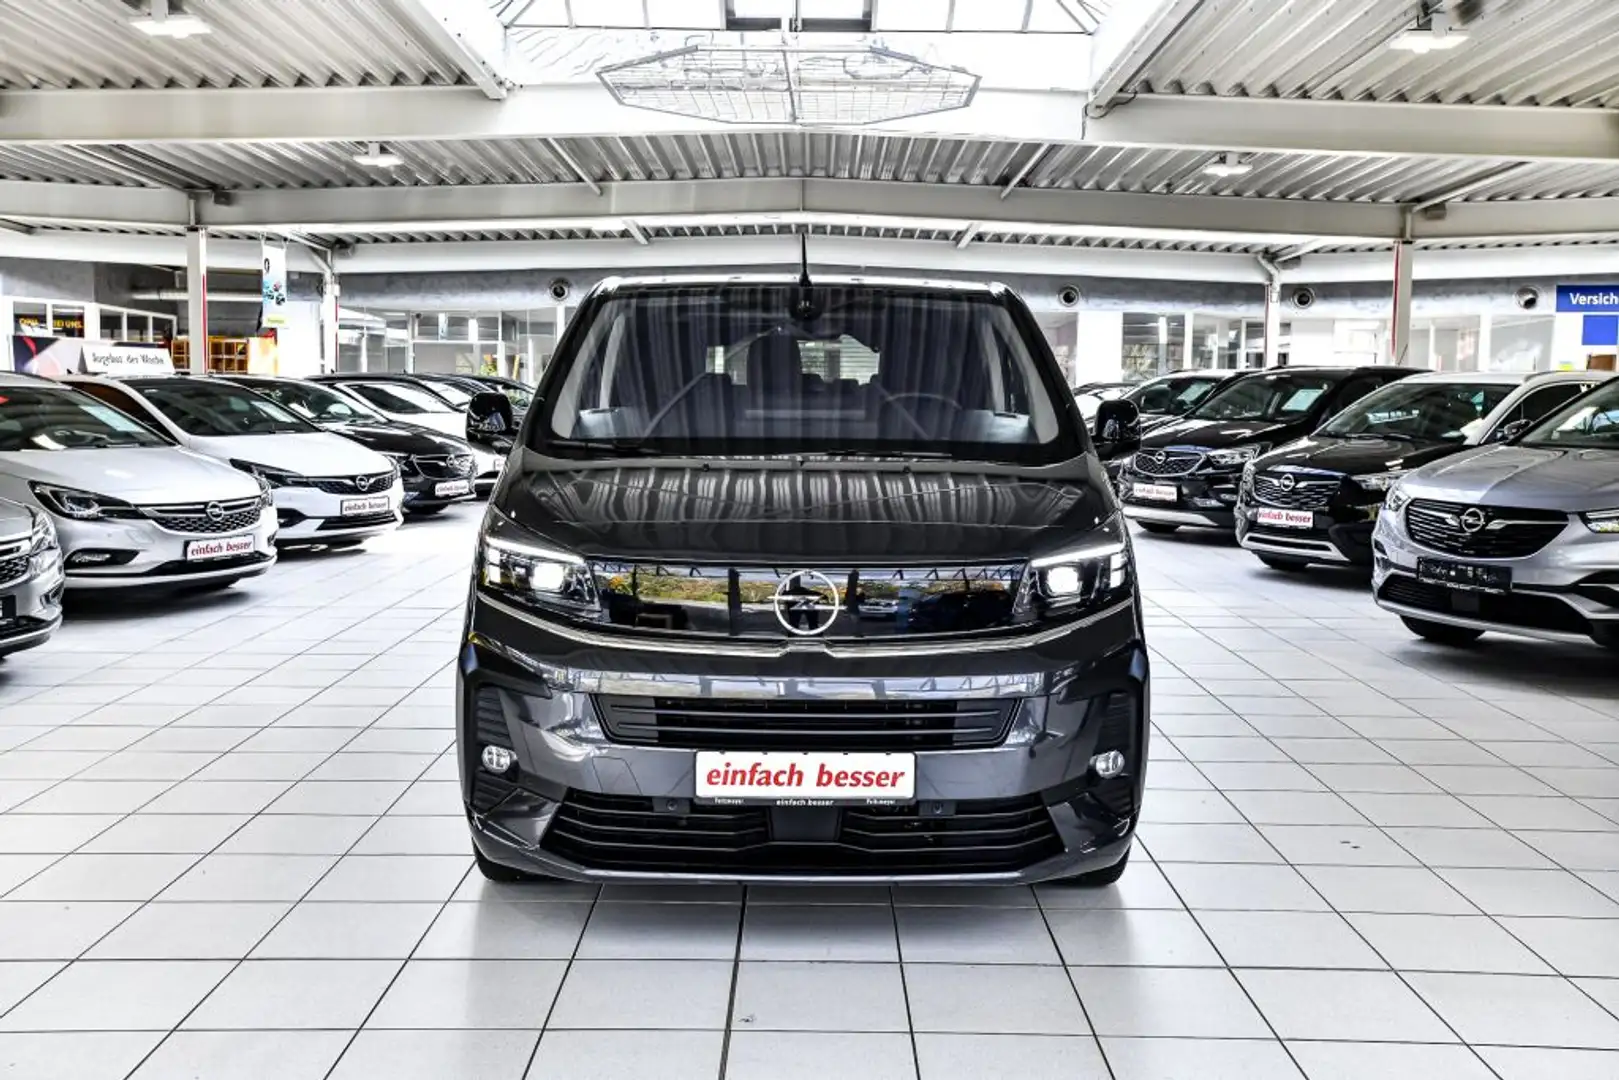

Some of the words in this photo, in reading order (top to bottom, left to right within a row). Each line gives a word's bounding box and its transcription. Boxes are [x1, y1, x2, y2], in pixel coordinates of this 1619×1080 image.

[1569, 292, 1619, 305] Versich
[1285, 512, 1311, 523] besser
[191, 542, 223, 556] einfach
[226, 541, 252, 552] besser
[707, 762, 804, 787] einfach
[816, 763, 905, 787] besser
[776, 797, 807, 807] einfach
[807, 798, 835, 807] besser
